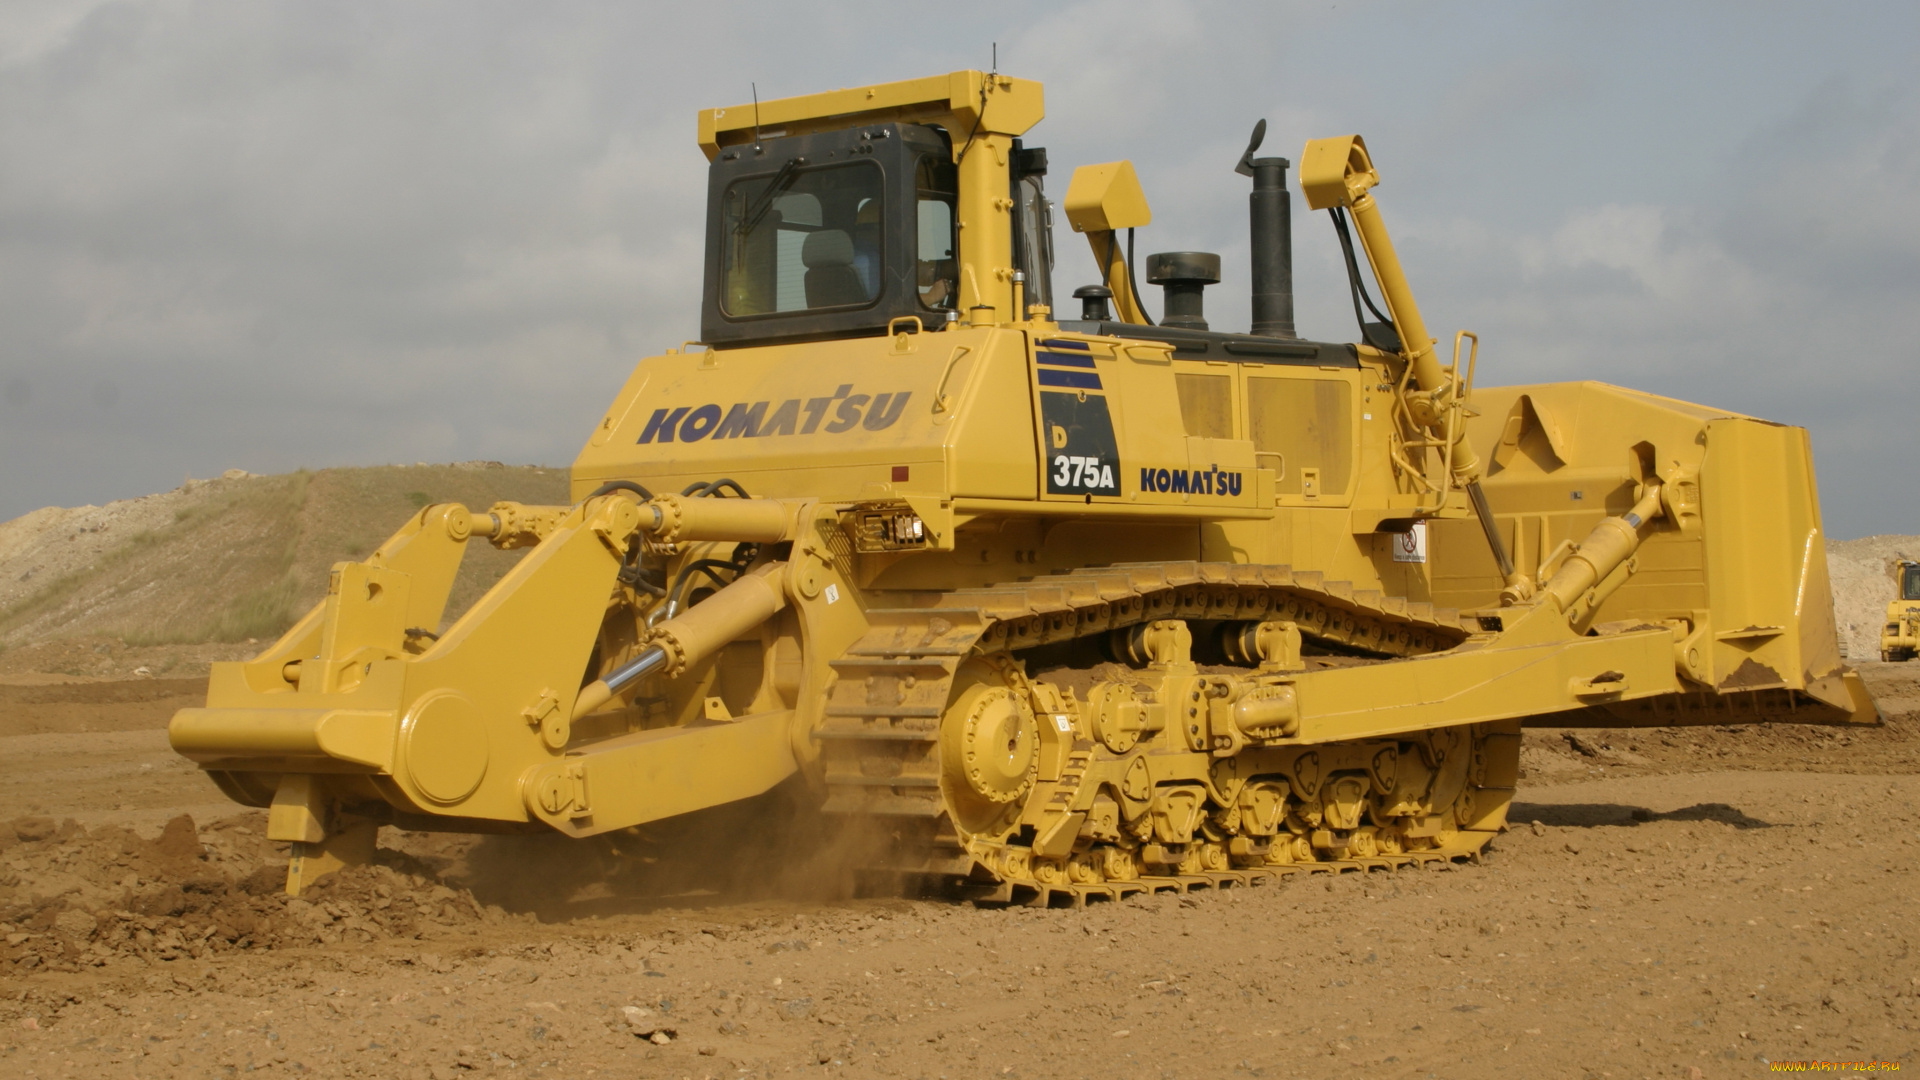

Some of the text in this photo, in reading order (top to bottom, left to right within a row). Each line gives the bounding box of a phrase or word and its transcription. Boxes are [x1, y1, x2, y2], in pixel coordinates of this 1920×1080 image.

[636, 384, 912, 445] KOMATSU
[1052, 426, 1067, 449] D
[1053, 455, 1115, 489] 375A
[1141, 464, 1242, 497] KOMATSU
